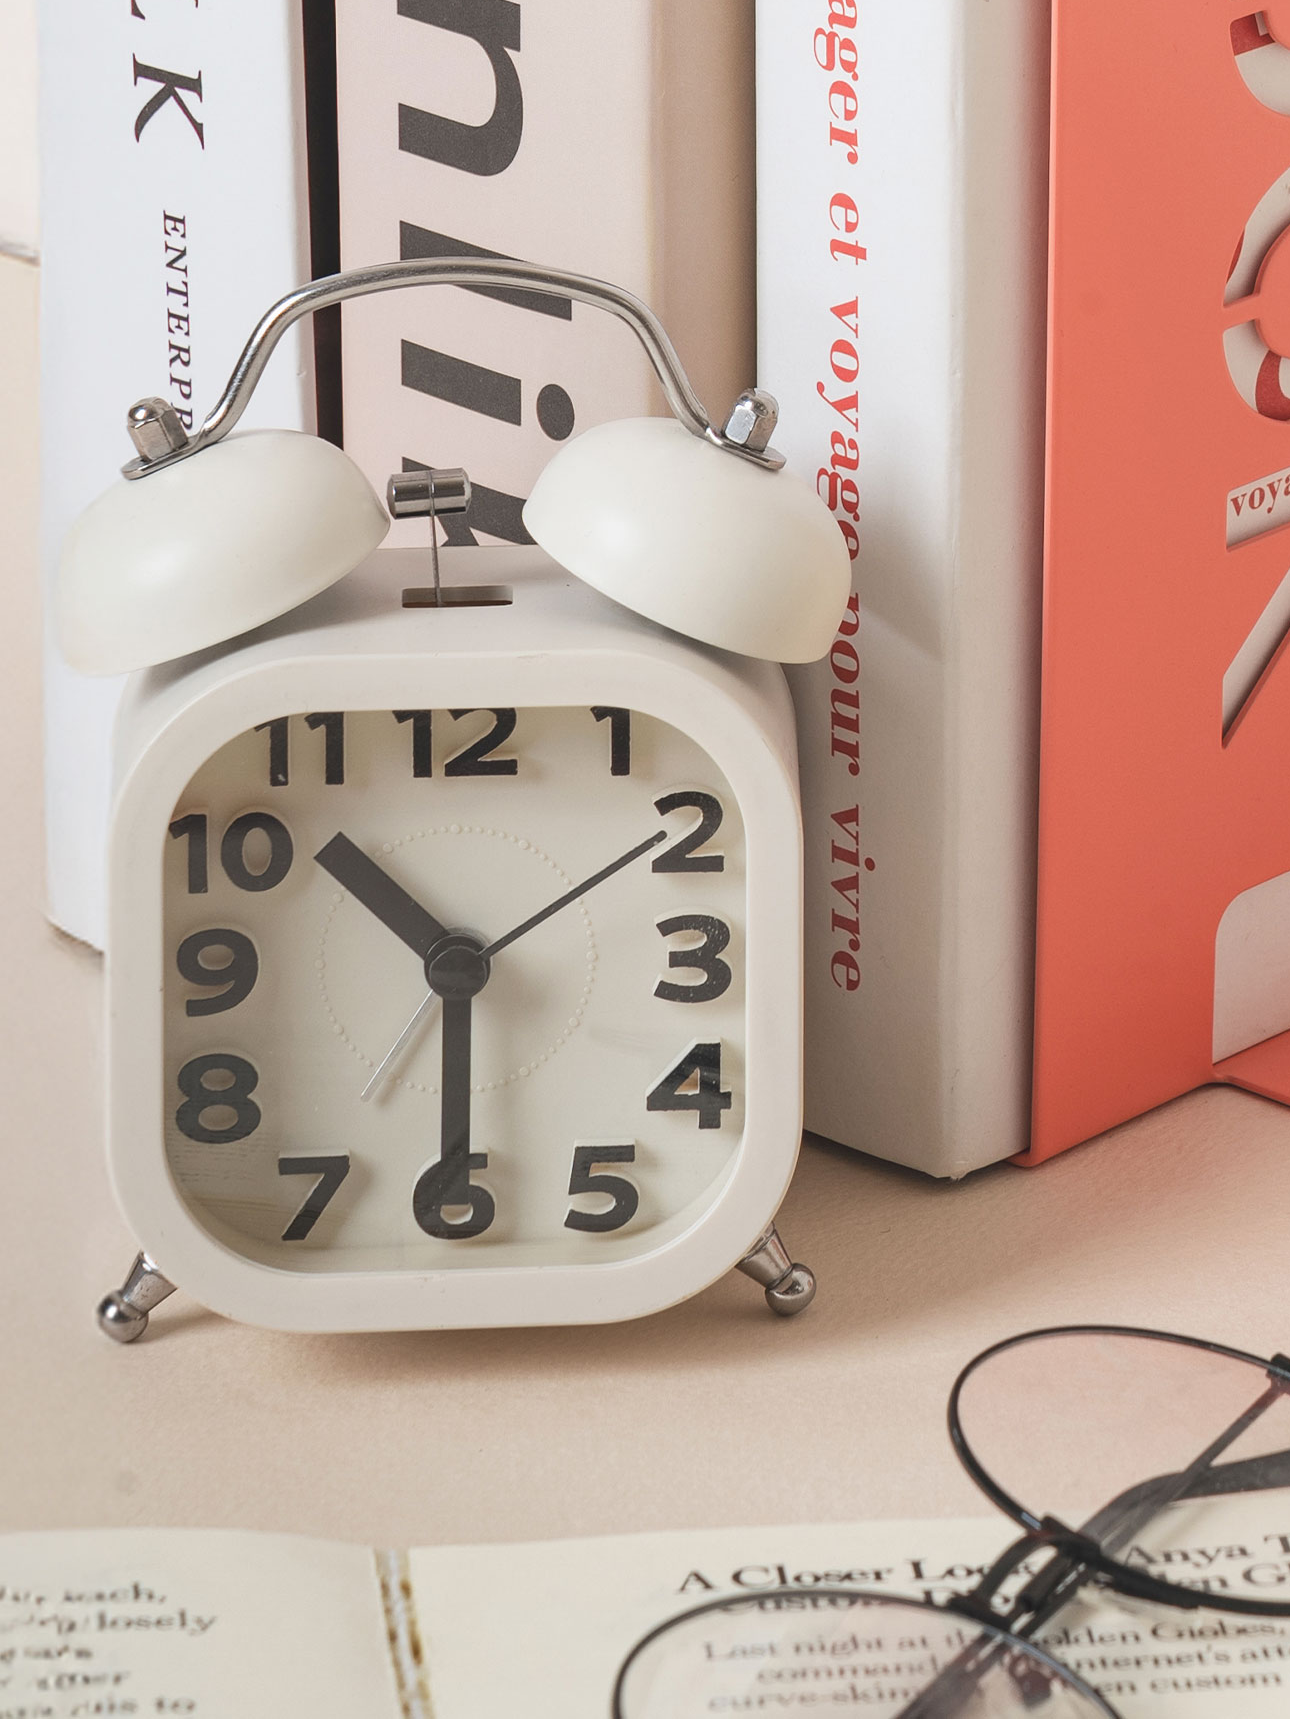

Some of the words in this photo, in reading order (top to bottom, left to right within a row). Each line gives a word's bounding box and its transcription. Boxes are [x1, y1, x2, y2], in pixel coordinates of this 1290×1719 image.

[828, 192, 868, 266] et
[255, 710, 346, 786] 11
[391, 708, 518, 779] 12
[590, 705, 632, 776] 1
[168, 811, 294, 895] 10
[651, 790, 725, 874] 2
[830, 804, 876, 992] vivre
[176, 928, 260, 1018] 9
[653, 914, 733, 1003] 3
[175, 1053, 262, 1144] 8
[646, 1042, 733, 1130] 4
[277, 1154, 351, 1242] 7
[412, 1151, 496, 1241] 6
[563, 1145, 640, 1233] 5
[678, 1569, 716, 1594] A
[731, 1563, 894, 1590] Closer
[1123, 1545, 1252, 1568] Anya
[703, 1640, 778, 1662] Last
[792, 1634, 885, 1660] night
[898, 1634, 930, 1650] at
[1150, 1673, 1283, 1694] custom
